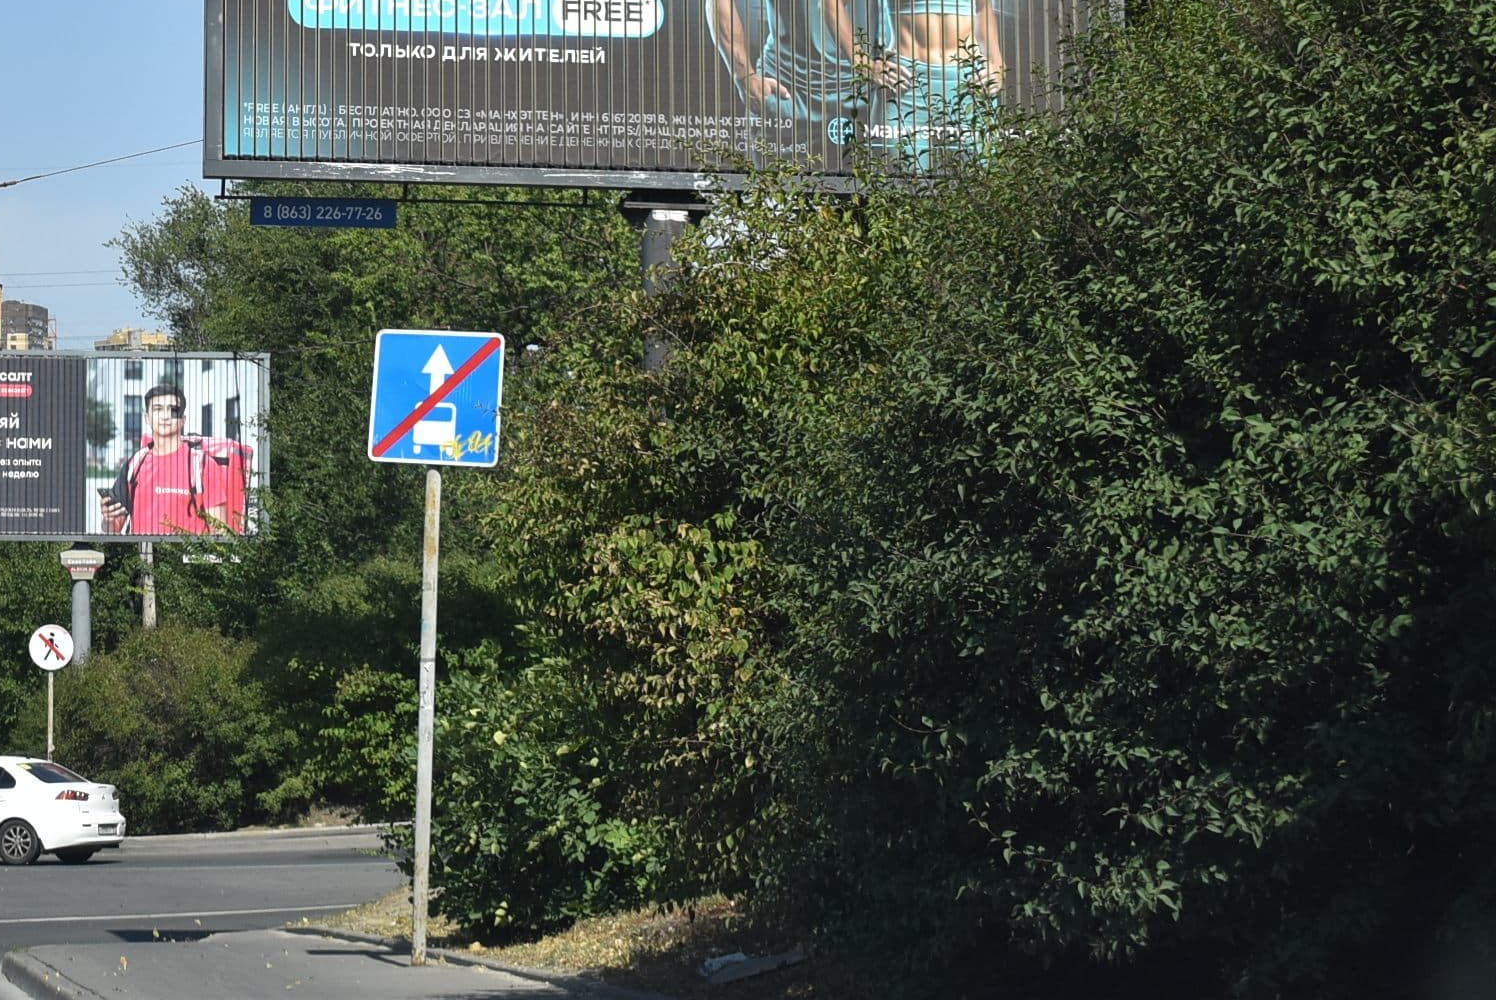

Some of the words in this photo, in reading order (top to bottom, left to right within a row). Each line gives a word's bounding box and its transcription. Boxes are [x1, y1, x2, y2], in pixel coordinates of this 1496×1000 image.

[347, 42, 436, 60] ТОЛЬКО
[442, 45, 488, 62] ДЛЯ
[494, 46, 606, 64] ЖИТЕЛЕЙ
[243, 114, 286, 126] НОВАЯ
[352, 117, 431, 130] ПРОЕКТНАЯ
[433, 119, 524, 133] ДЕКЛАРАЦИЯ
[526, 123, 545, 133] НА
[263, 204, 273, 219] 8
[277, 203, 312, 221] (863)
[315, 205, 383, 221] 226-77-26
[6, 437, 52, 450] нами
[12, 458, 42, 467] опыта
